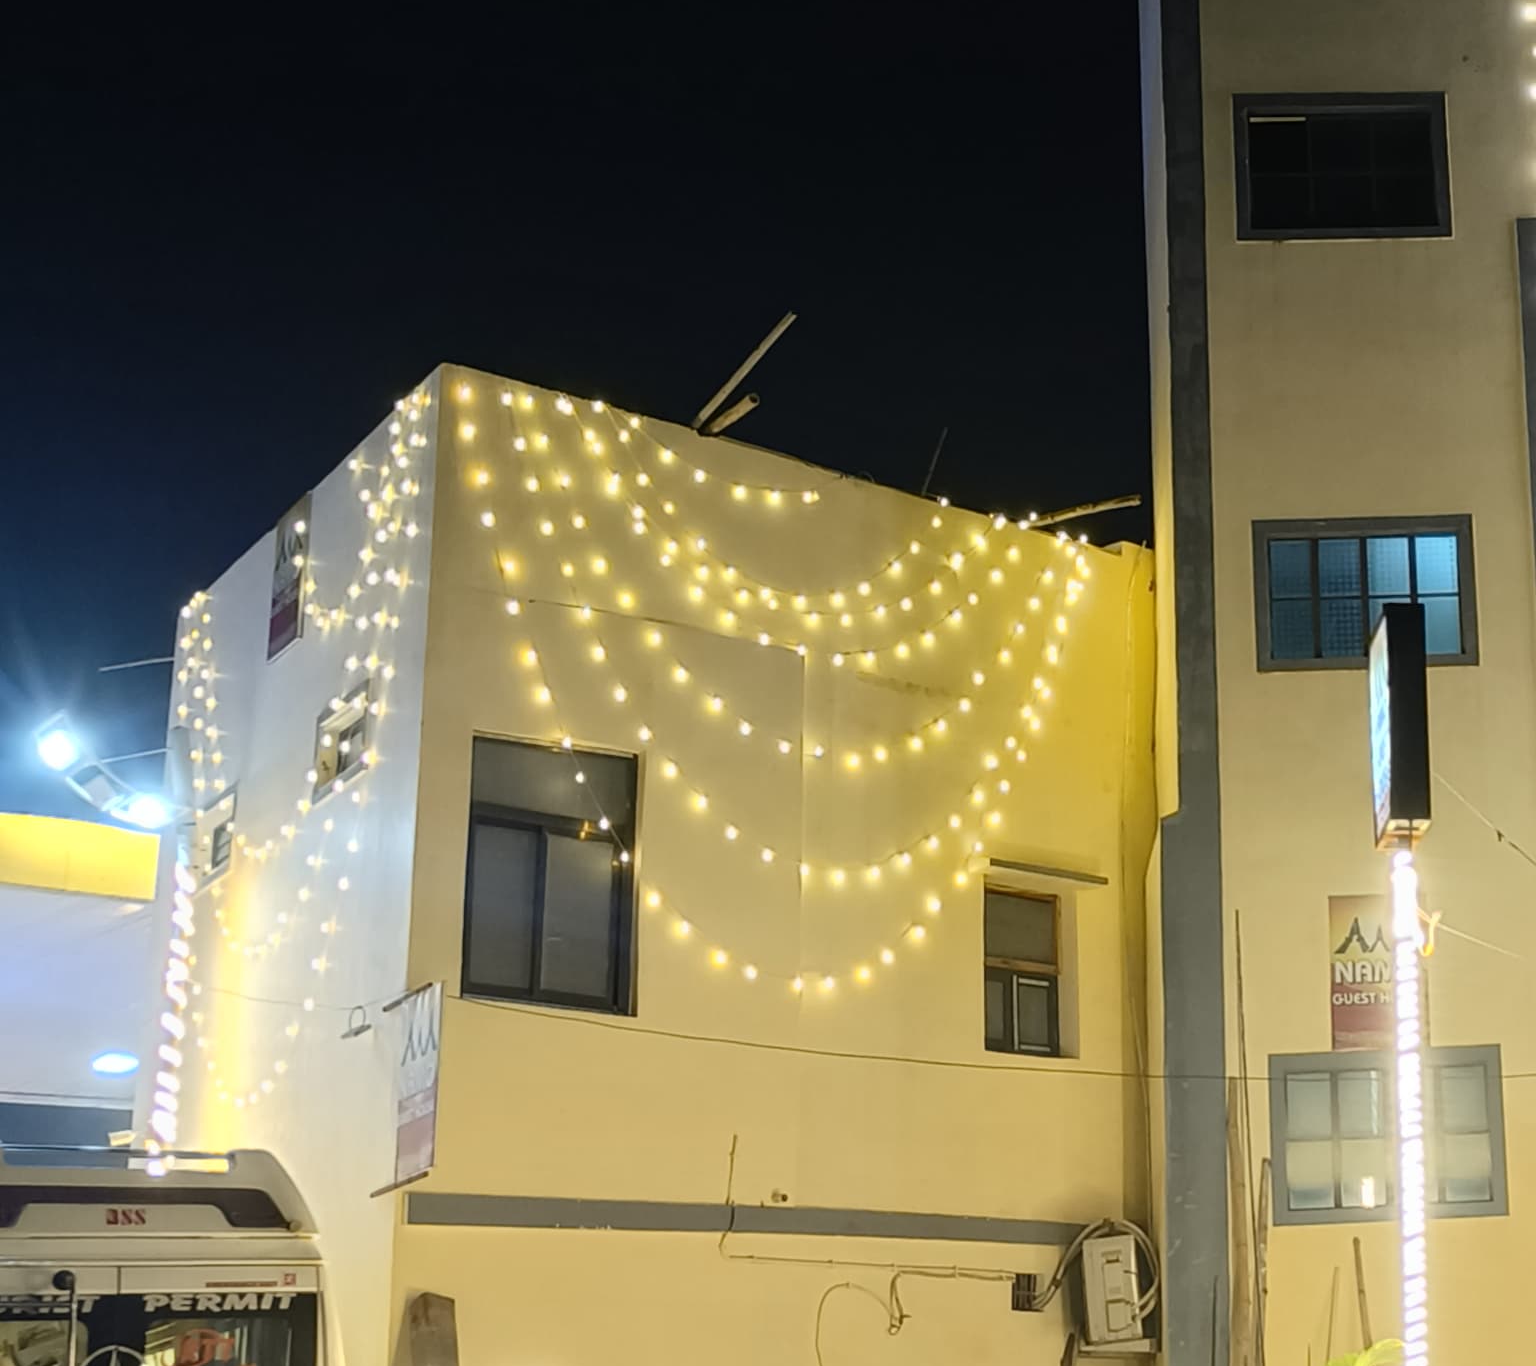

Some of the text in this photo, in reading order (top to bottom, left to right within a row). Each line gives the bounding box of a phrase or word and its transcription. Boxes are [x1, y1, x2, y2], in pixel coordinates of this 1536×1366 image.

[1335, 960, 1394, 984] NAM
[1332, 992, 1376, 1006] GUEST
[143, 1293, 297, 1313] PERMIT
